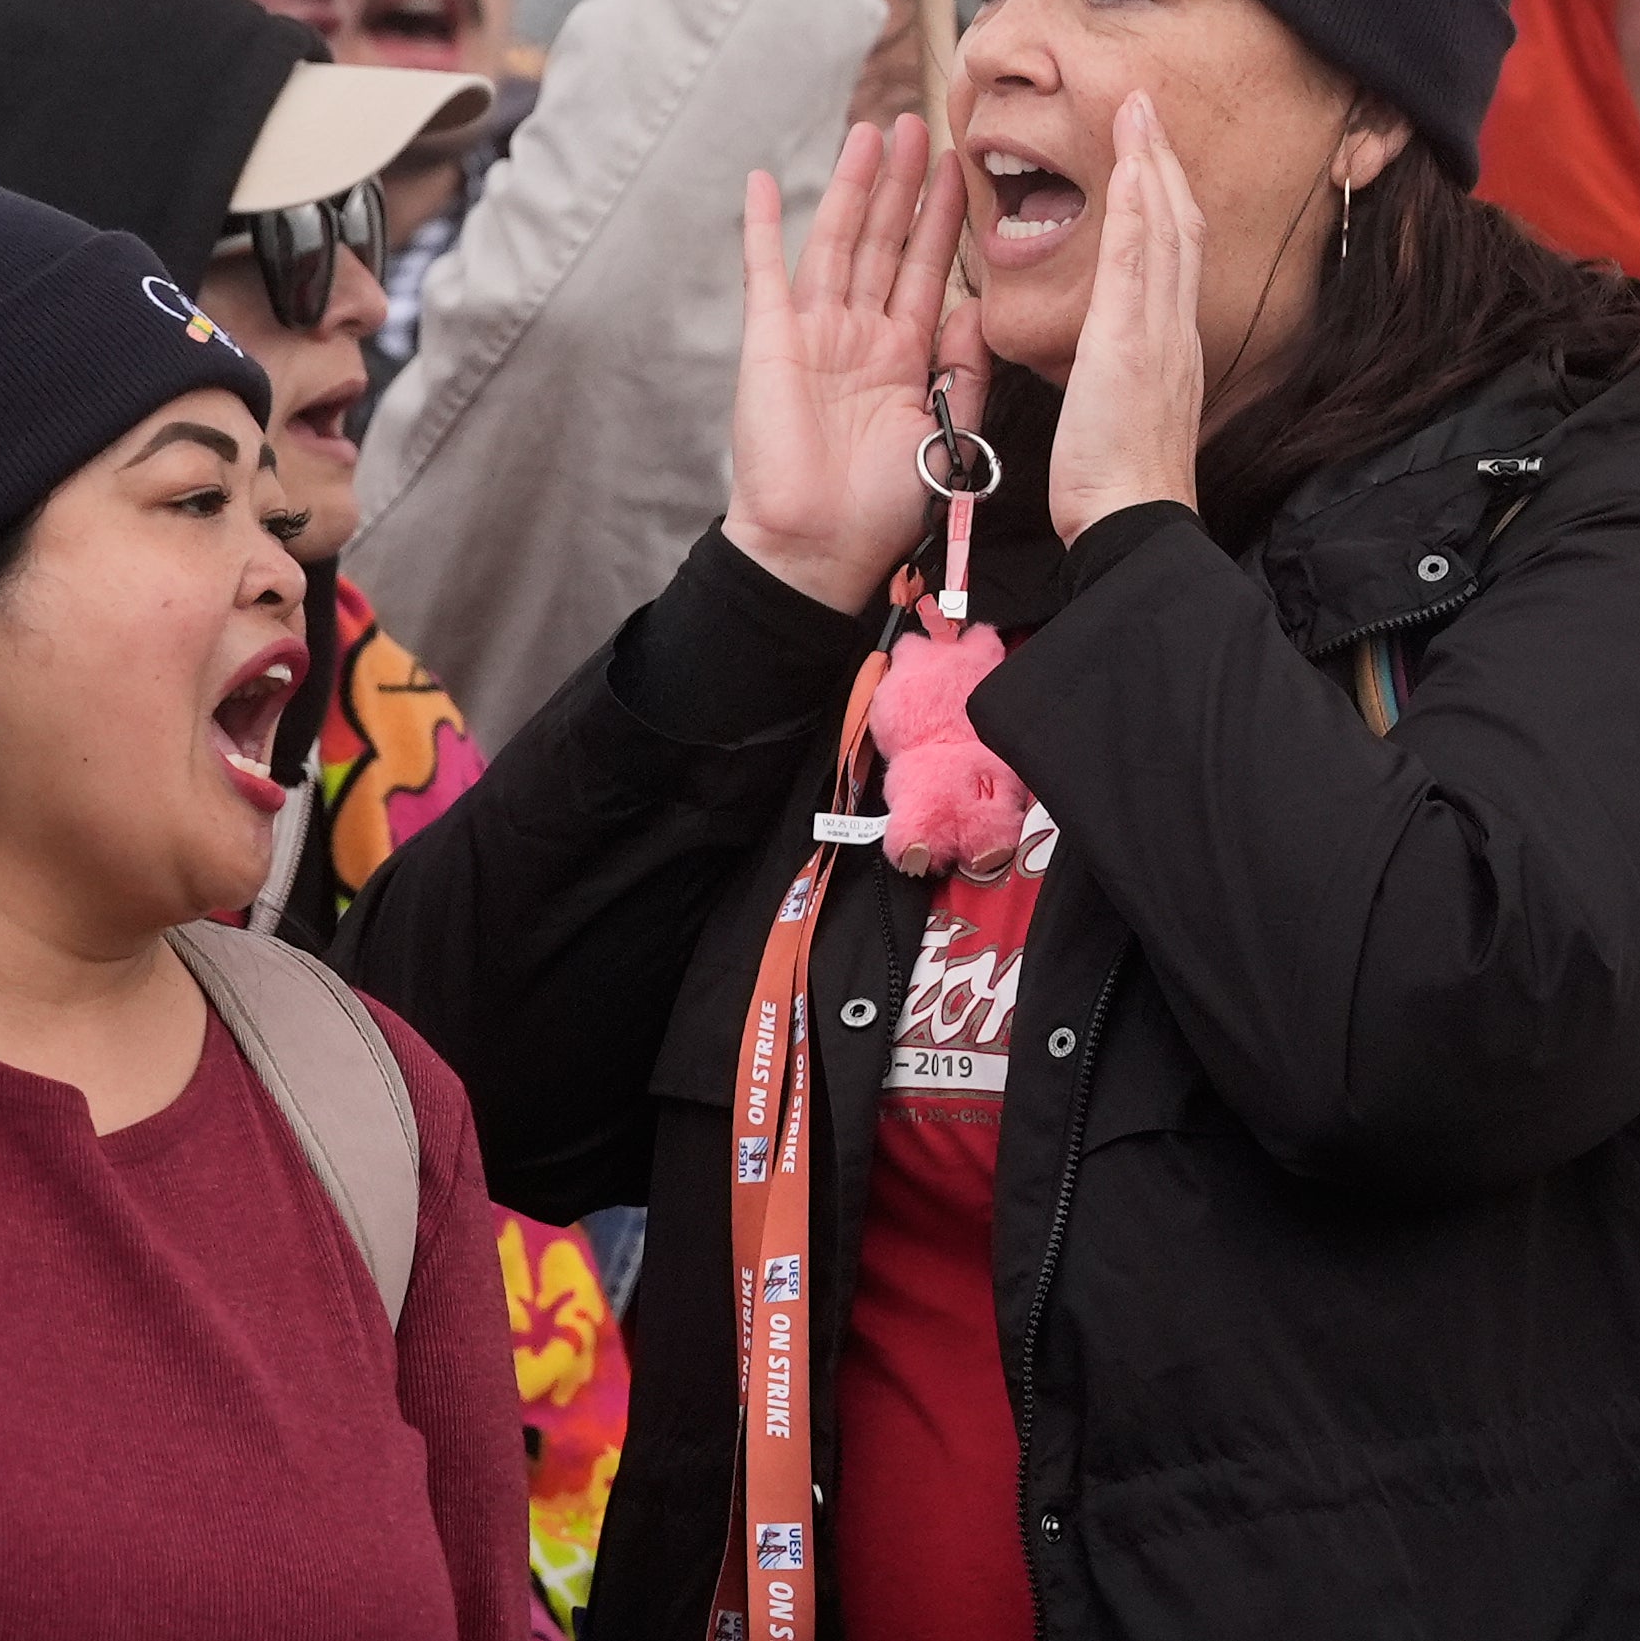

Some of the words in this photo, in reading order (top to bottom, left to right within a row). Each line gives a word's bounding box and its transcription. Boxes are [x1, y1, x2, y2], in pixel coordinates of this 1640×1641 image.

[976, 774, 995, 801] N
[752, 1000, 778, 1084] STRIKE
[793, 1053, 805, 1090] ON
[747, 1086, 768, 1125] ON
[781, 1095, 803, 1174] STRIKE
[738, 1141, 749, 1178] UESF
[788, 1259, 799, 1296] UESF
[741, 1266, 754, 1351] STRIKE
[769, 1312, 792, 1351] ON
[741, 1355, 750, 1393] ON
[766, 1354, 792, 1440] STRIKE
[788, 1527, 802, 1566] UESF
[768, 1580, 795, 1622] ON
